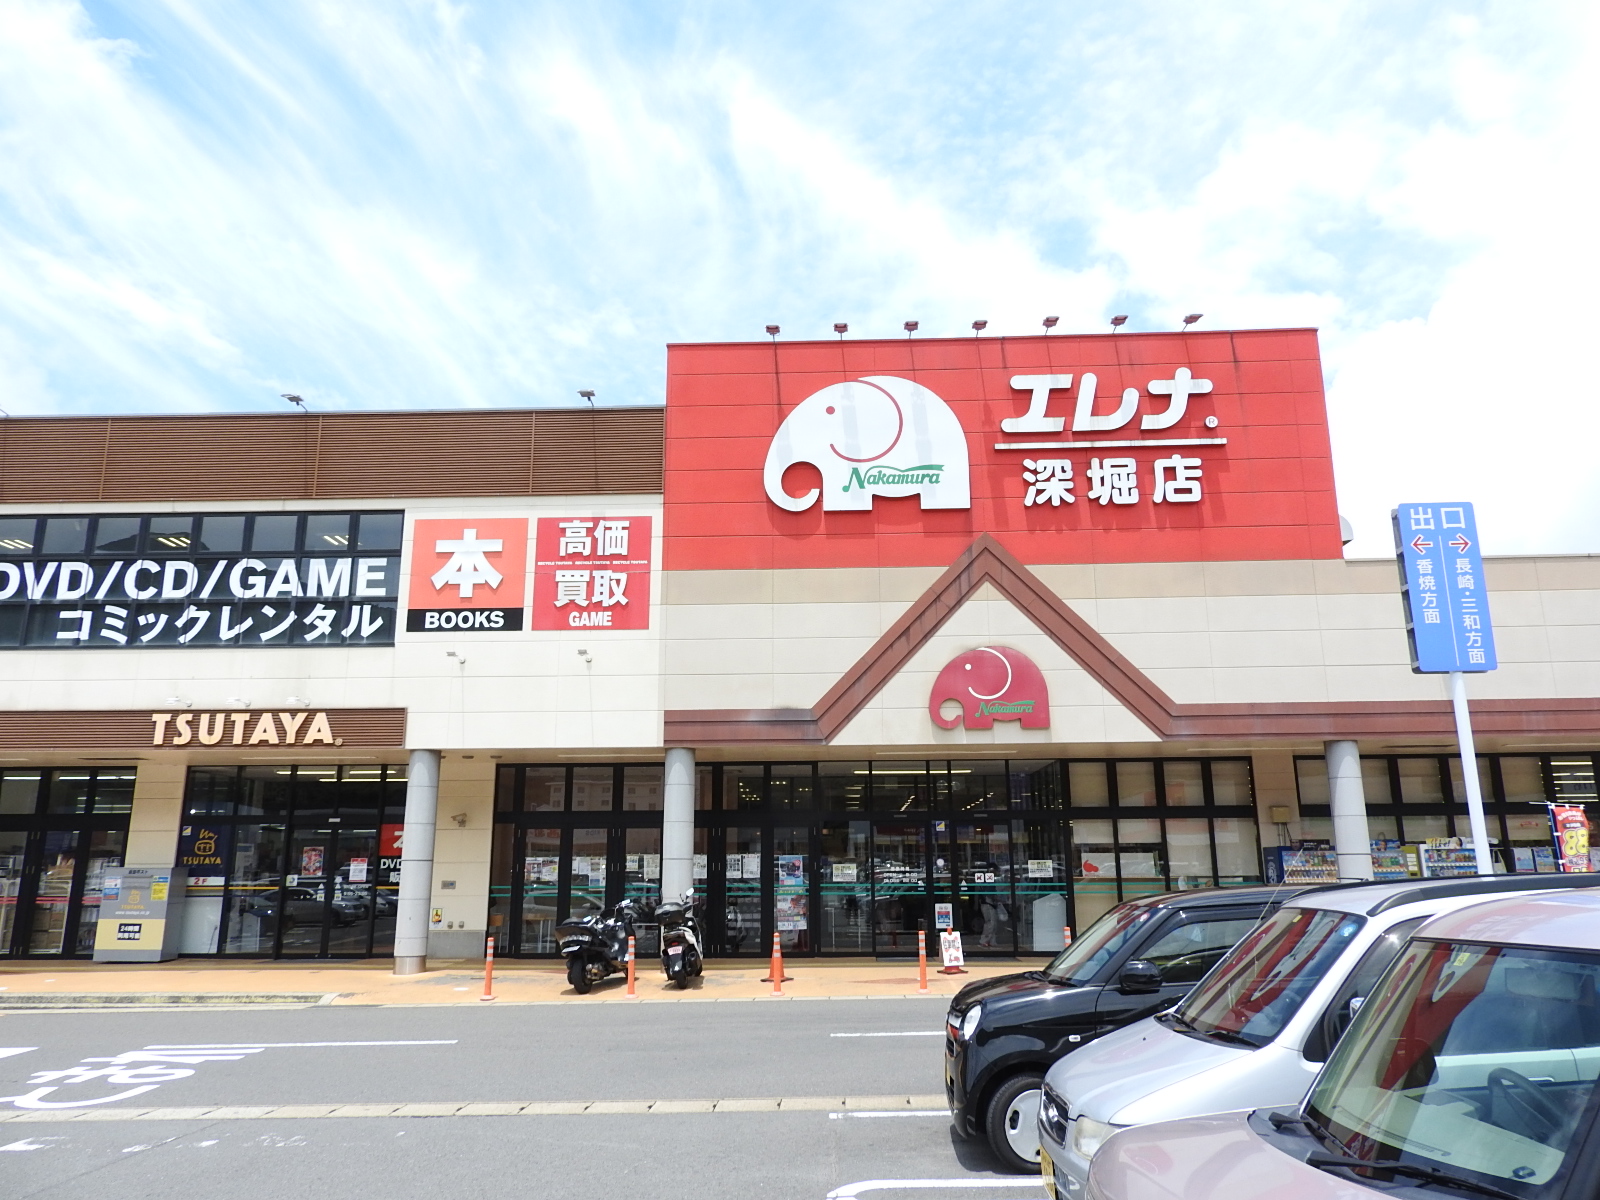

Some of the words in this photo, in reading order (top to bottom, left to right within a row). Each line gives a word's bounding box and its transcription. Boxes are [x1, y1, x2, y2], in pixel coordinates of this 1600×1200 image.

[1001, 367, 1213, 433] エレナ
[842, 464, 944, 492] Nakamura
[1022, 454, 1203, 507] 深堀店
[1410, 506, 1466, 530] 出口
[559, 520, 630, 556] 高価
[0, 558, 388, 600] DVD/CD/GAME
[431, 528, 503, 598] 本
[554, 569, 629, 608] 買取
[1416, 558, 1441, 624] 香焼方面
[56, 603, 384, 645] コミックレンタル
[424, 611, 505, 629] BOOKS
[568, 611, 612, 627] GAME
[975, 700, 1035, 717] Nakamura
[151, 712, 334, 745] TSUTAYA
[182, 856, 222, 865] TSUTAYA
